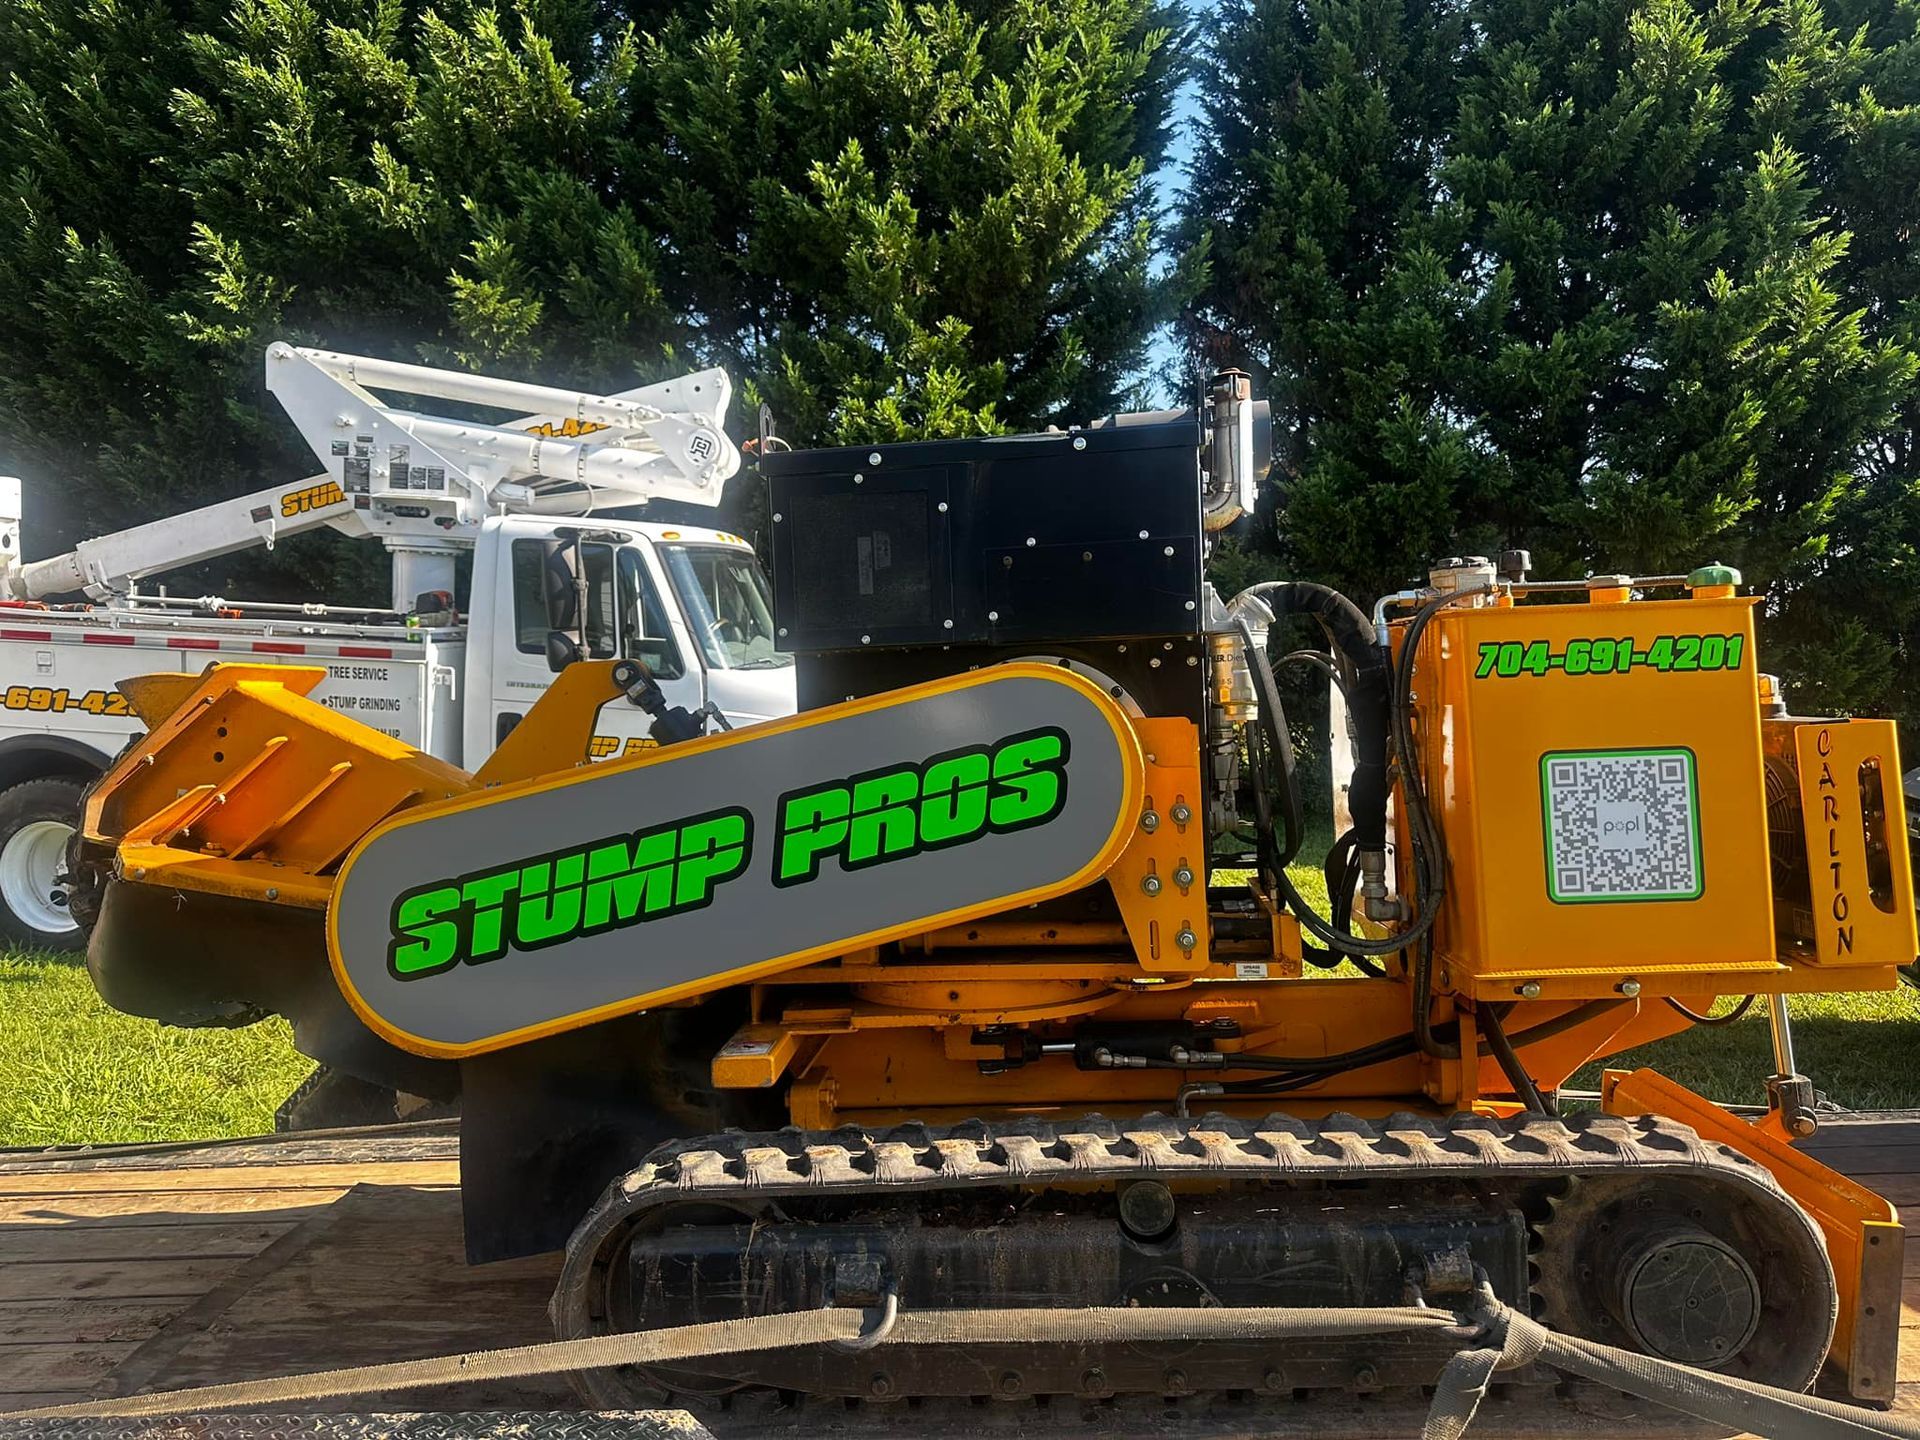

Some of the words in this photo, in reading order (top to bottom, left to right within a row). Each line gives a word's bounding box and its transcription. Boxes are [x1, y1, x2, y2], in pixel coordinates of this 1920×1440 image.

[328, 666, 350, 679] TREE
[352, 667, 388, 681] SERVICE
[1475, 633, 1744, 679] 704-691-4201
[328, 695, 357, 709] STUMP
[359, 697, 400, 711] GRINDING
[387, 806, 754, 981] STUMP
[771, 725, 1071, 888] PROS
[1818, 729, 1853, 956] CARLTON
